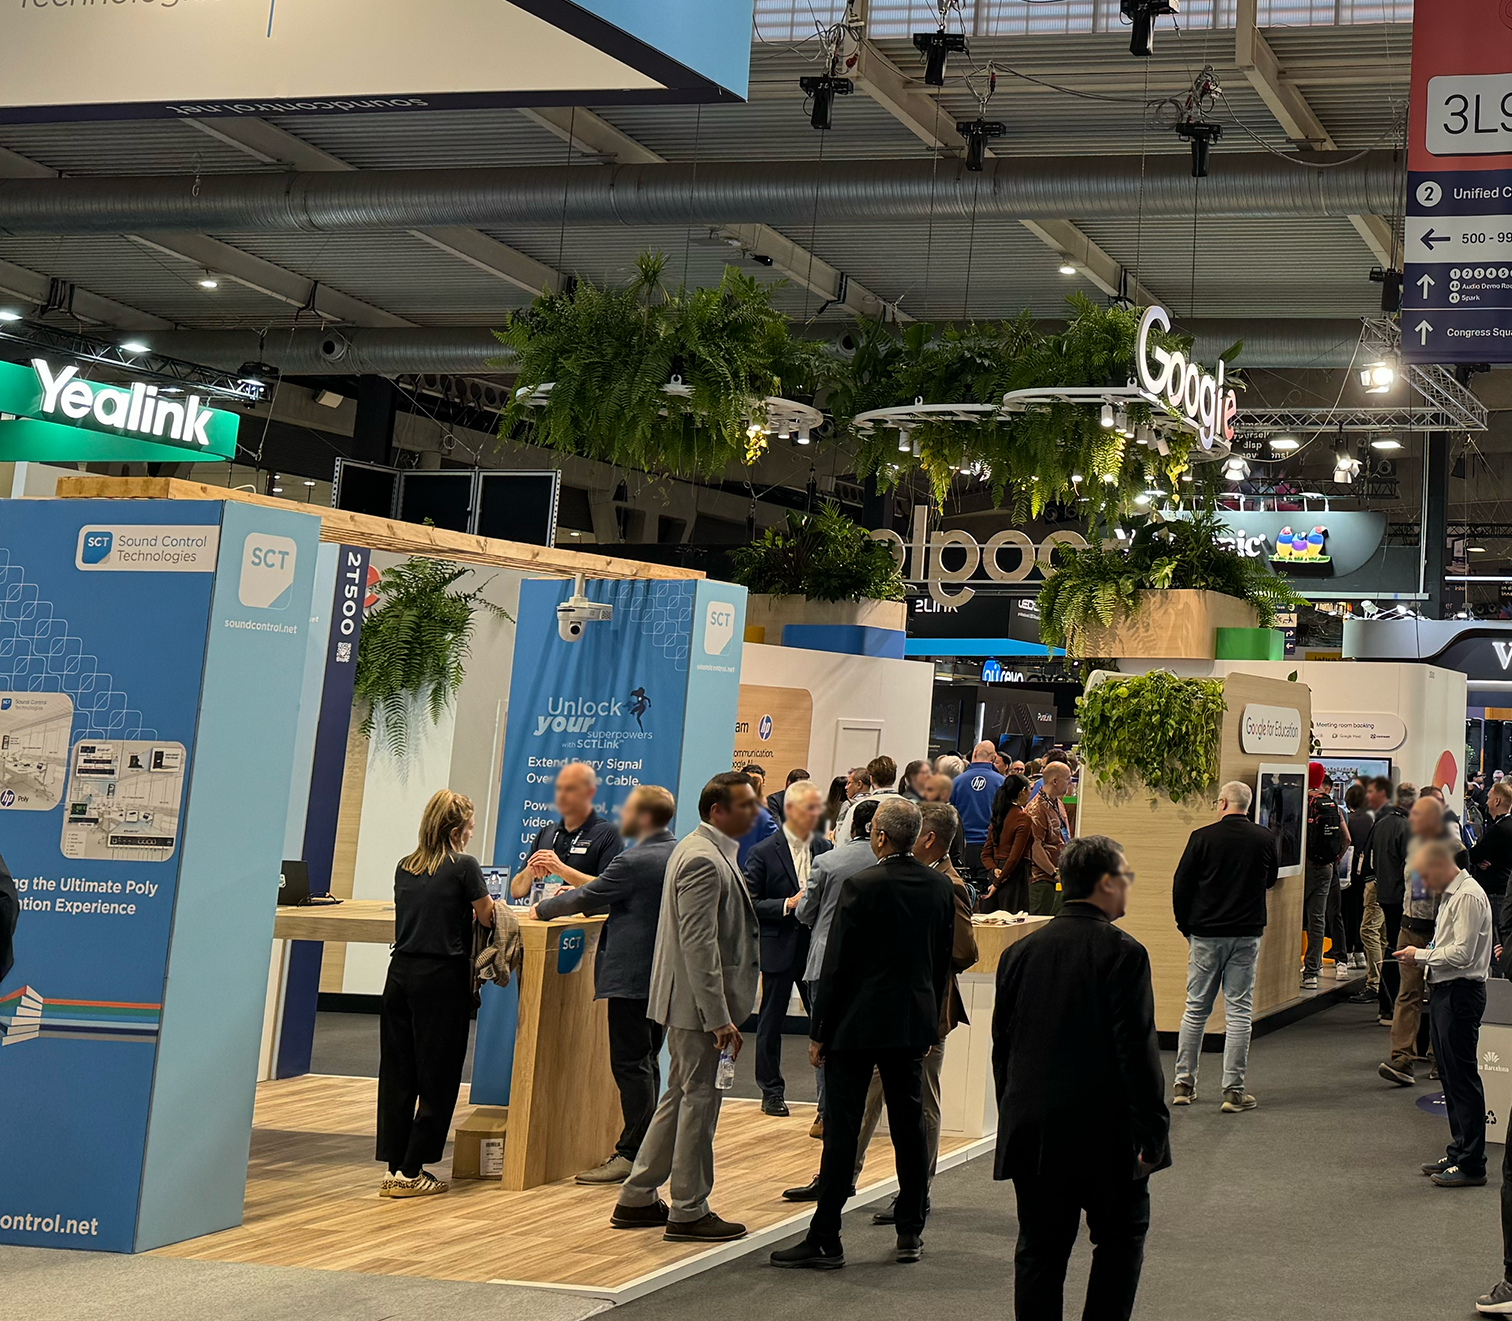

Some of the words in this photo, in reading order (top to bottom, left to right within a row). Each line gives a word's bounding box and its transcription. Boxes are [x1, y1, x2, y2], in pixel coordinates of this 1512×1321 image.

[165, 97, 429, 116] soundcontrol.net
[1424, 186, 1434, 201] 2
[1453, 187, 1500, 199] Unified
[1461, 232, 1486, 244] 500
[1446, 327, 1491, 338] Congress
[1135, 304, 1237, 450] Google
[31, 357, 210, 447] Yealink
[87, 536, 110, 548] SCT
[118, 535, 161, 547] Sound
[163, 535, 208, 549] Control
[117, 550, 198, 564] Technologies
[250, 547, 290, 570] SCT
[339, 551, 362, 636] 2T500
[224, 618, 298, 635] soundcontrol.net
[710, 611, 731, 628] SCT
[547, 696, 623, 717] Unlock
[532, 715, 597, 737] your
[1246, 716, 1267, 741] Google
[1266, 719, 1275, 737] for
[1274, 720, 1299, 739] Education
[560, 740, 576, 748] with
[586, 729, 653, 742] superpowers
[527, 756, 569, 768] Extend
[606, 758, 643, 770] Signal
[605, 775, 642, 787] Cable.
[970, 775, 987, 792] hp
[17, 795, 30, 803] Poly
[32, 876, 57, 891] the
[60, 877, 122, 893] Ultimate
[125, 880, 159, 898] Poly
[54, 897, 137, 916] Experience
[562, 936, 582, 950] SCT
[0, 1213, 99, 1236] ontrol.net
